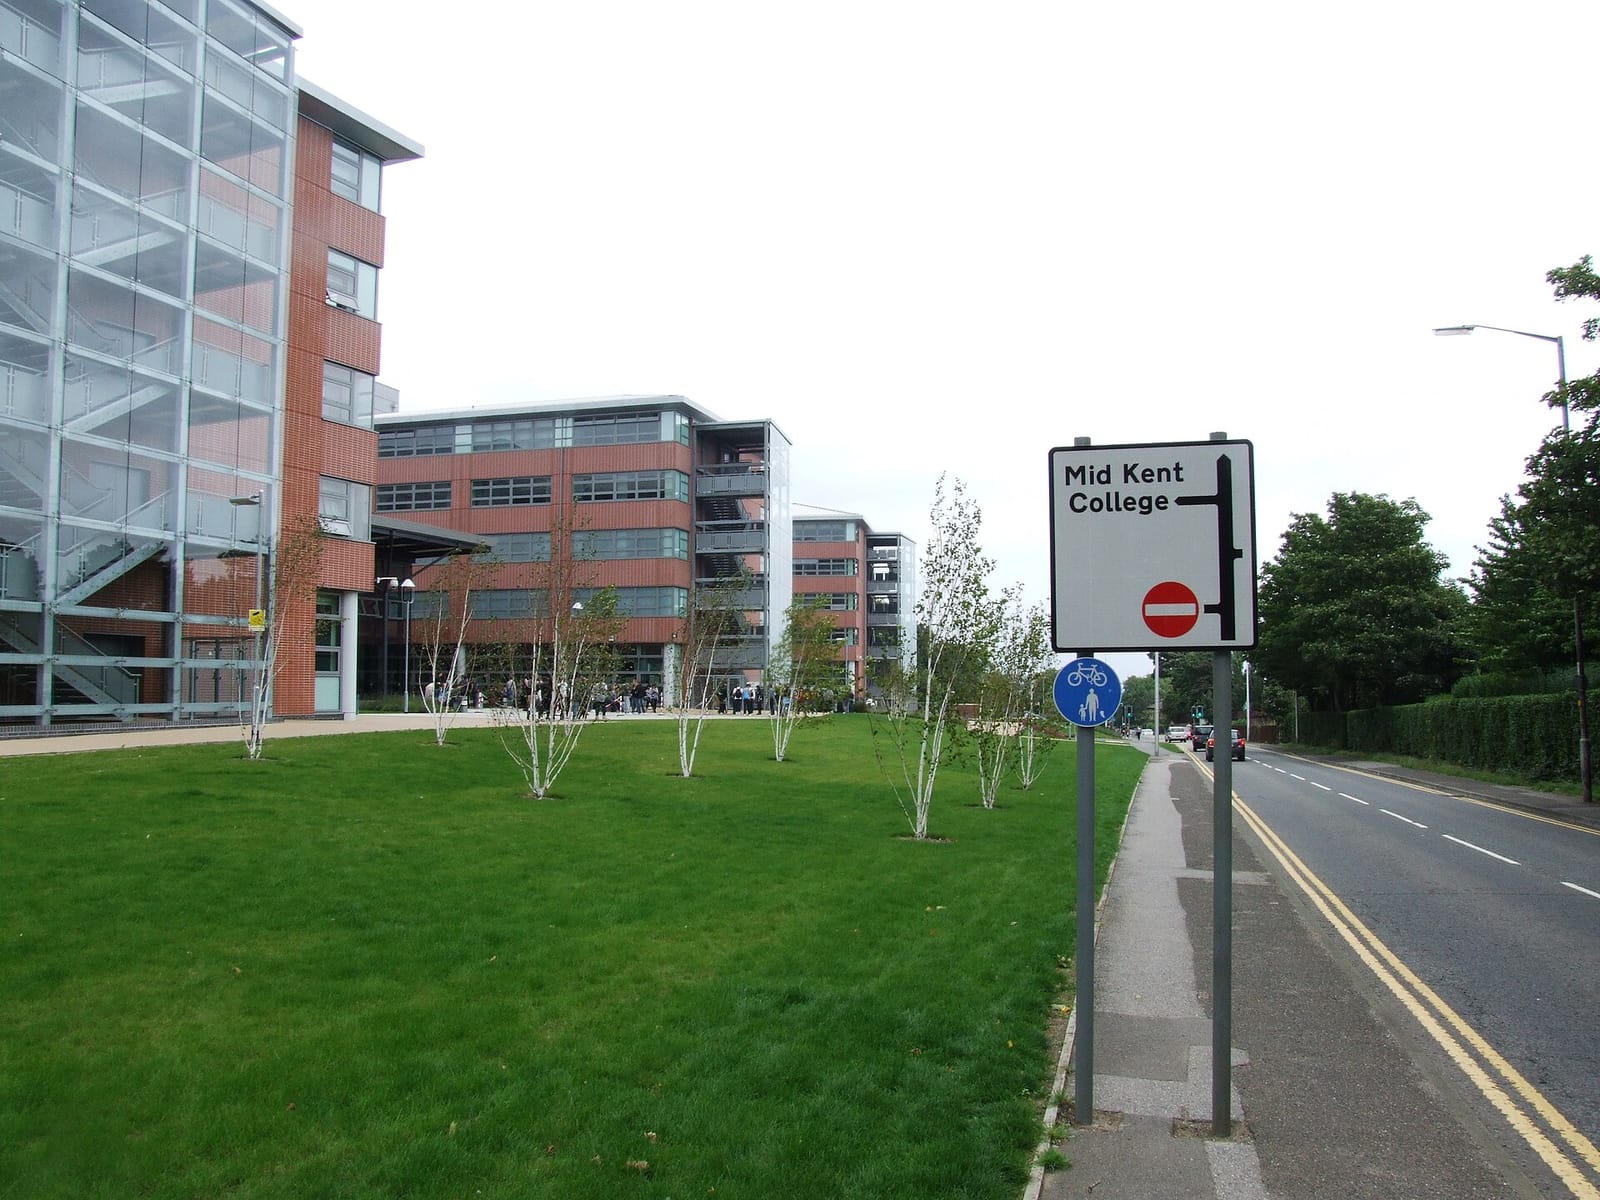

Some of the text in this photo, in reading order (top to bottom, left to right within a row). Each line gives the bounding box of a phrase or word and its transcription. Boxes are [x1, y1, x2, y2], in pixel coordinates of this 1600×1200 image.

[1065, 461, 1184, 486] Mid Kent
[1069, 491, 1169, 515] College
